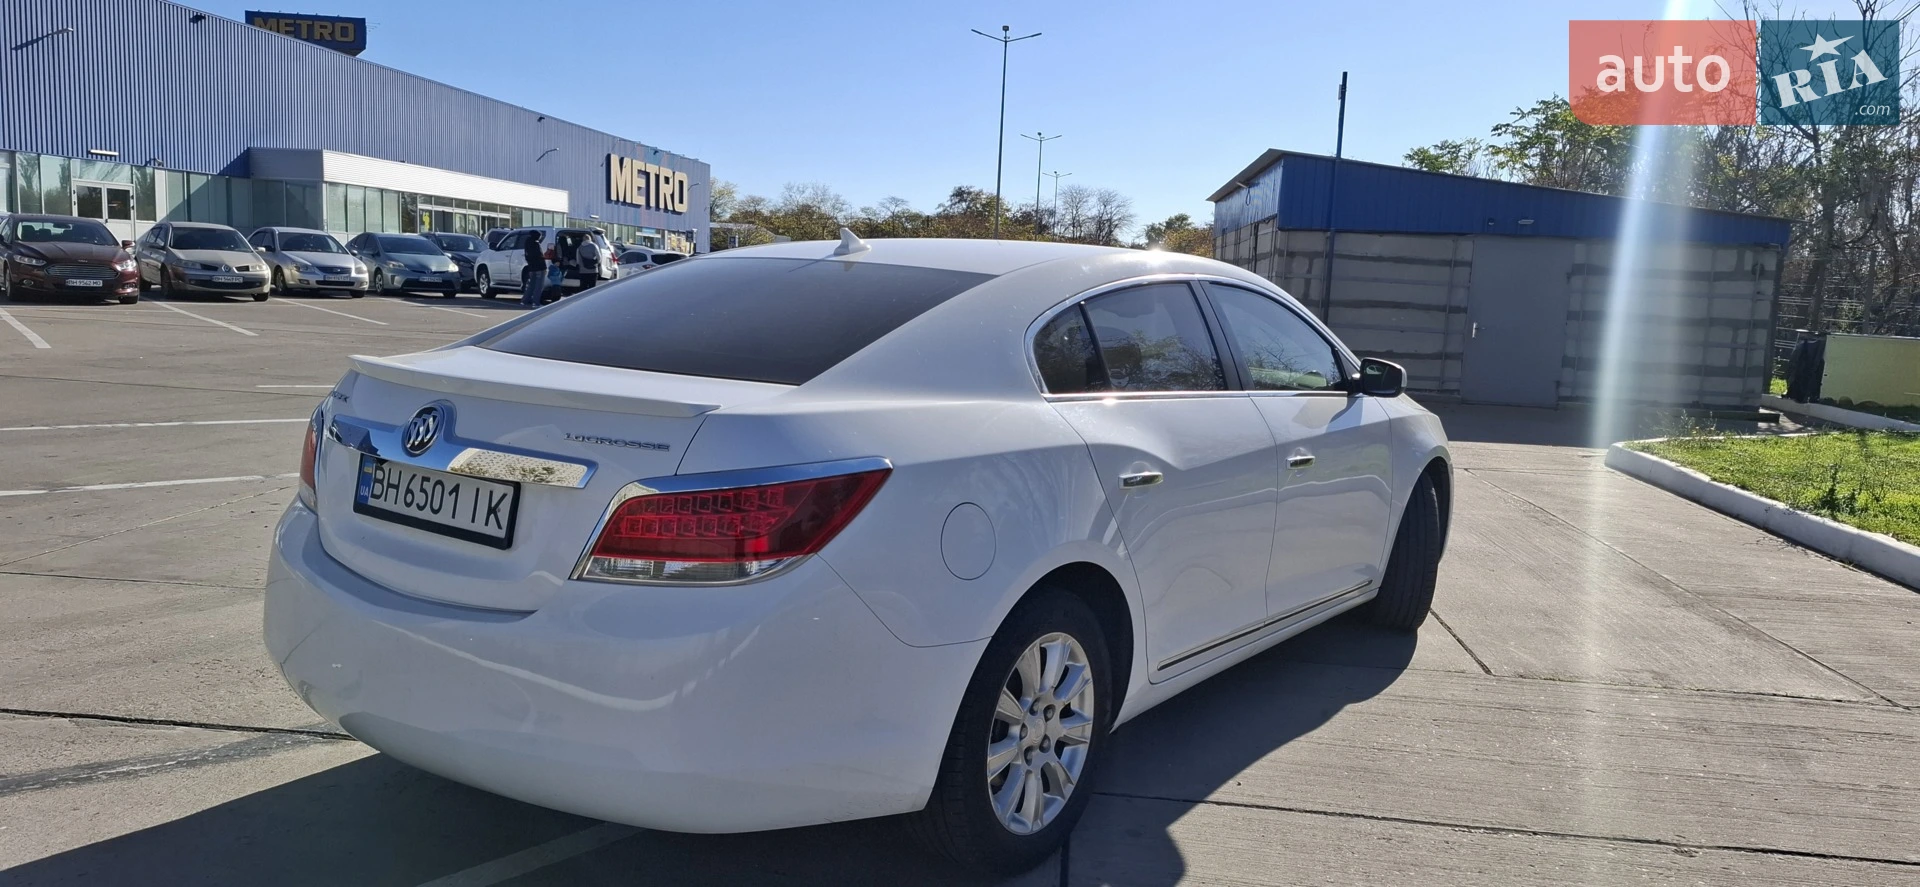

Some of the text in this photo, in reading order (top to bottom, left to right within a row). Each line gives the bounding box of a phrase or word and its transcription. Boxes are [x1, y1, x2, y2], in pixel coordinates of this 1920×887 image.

[254, 16, 355, 42] METRO
[610, 153, 688, 213] METRO
[359, 486, 369, 498] UA
[471, 487, 508, 530] IK
